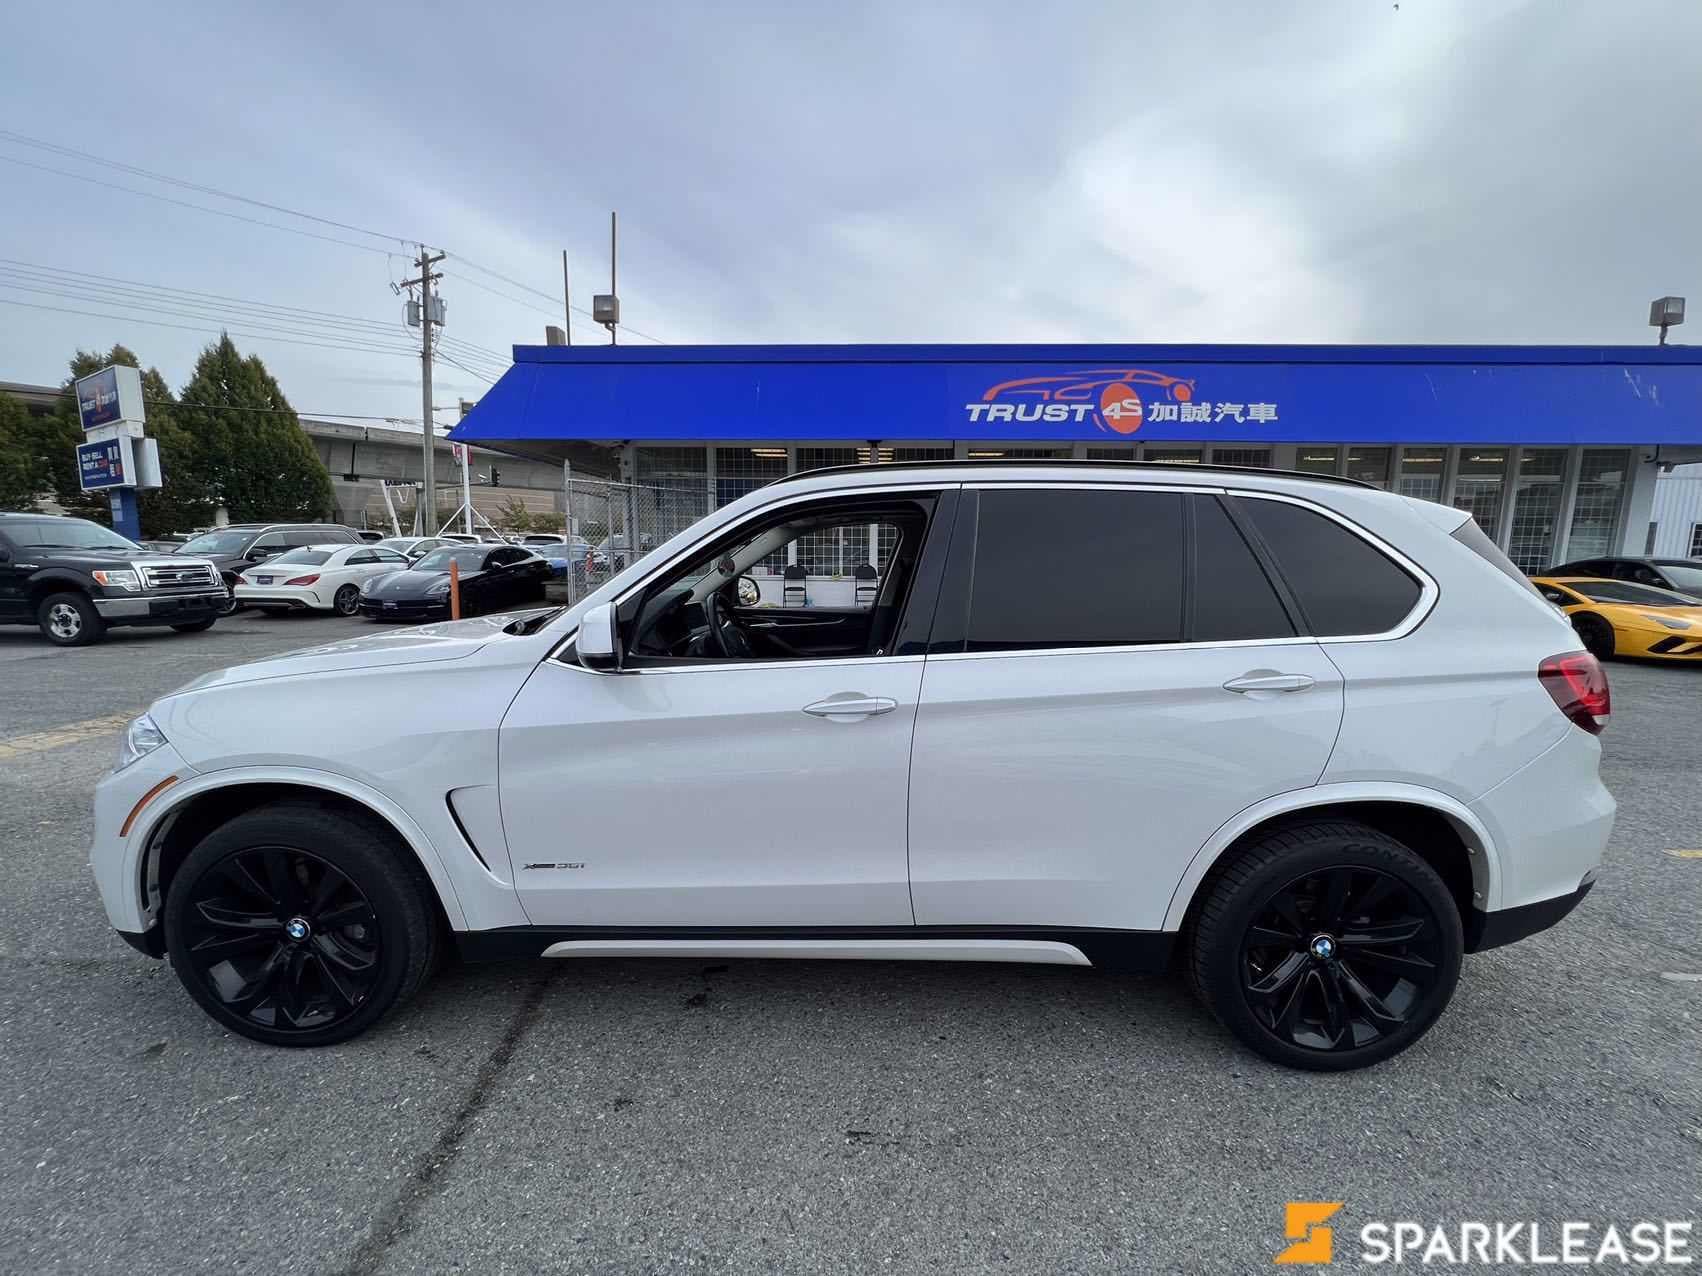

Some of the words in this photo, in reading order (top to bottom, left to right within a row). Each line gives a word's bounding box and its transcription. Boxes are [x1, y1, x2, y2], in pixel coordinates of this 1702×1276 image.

[965, 403, 1094, 422] TRUST
[1147, 401, 1279, 424] 加誠汽車
